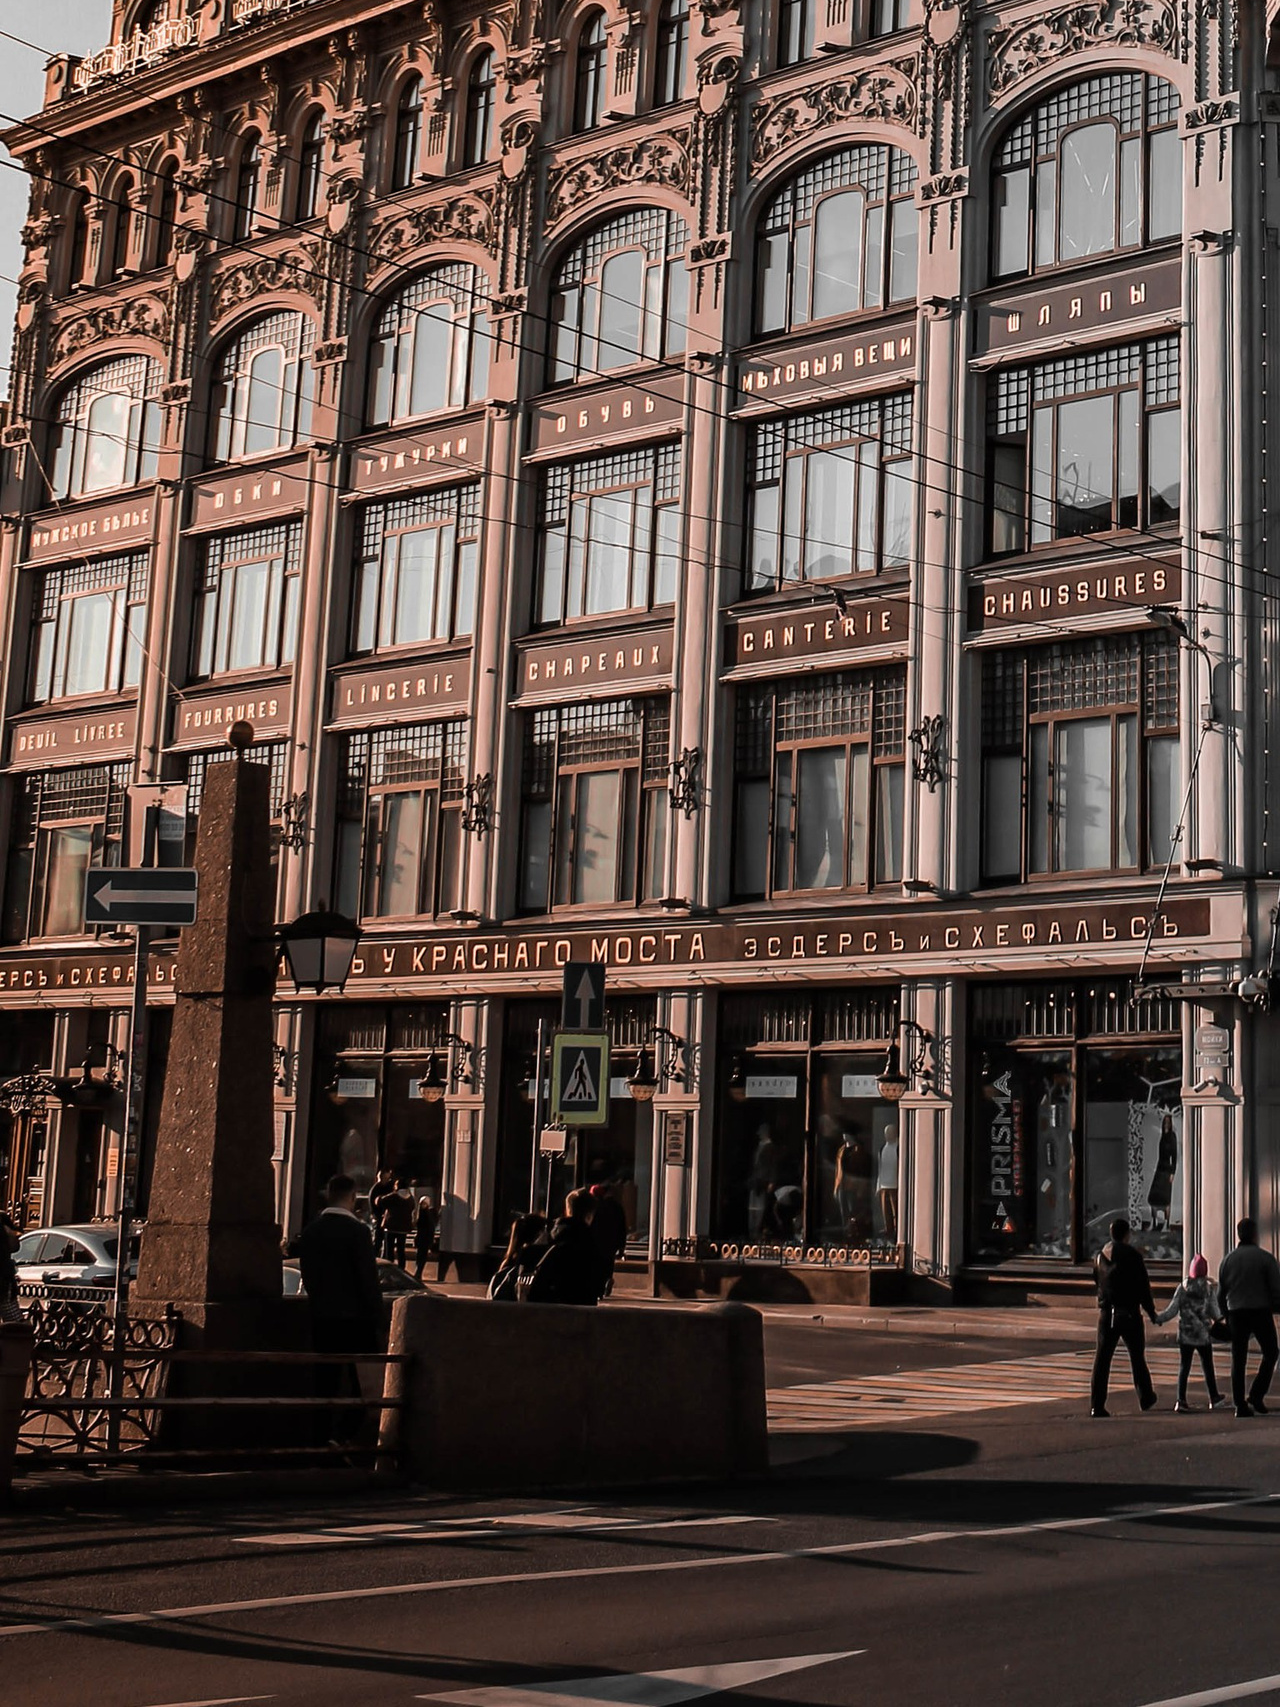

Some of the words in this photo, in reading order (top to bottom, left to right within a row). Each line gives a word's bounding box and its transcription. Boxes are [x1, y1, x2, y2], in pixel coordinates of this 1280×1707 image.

[1007, 283, 1146, 333] ШЛЯПЫ
[854, 336, 912, 368] ВЕЩИ
[556, 396, 655, 433] ОБУВЬ
[364, 437, 468, 476] ТУЖУРКИ
[32, 520, 97, 548] МУЖСКОЕ
[984, 569, 1167, 617] CHAUSSURES
[529, 645, 660, 681] CHAPEAUX
[184, 699, 278, 729] FOURRURES
[20, 730, 58, 752] DEUIL
[383, 947, 396, 973] У
[412, 940, 571, 972] КРАСНАГО
[591, 933, 706, 965] МОСТА
[744, 930, 905, 960] ЭСДЕРСЪ
[919, 935, 930, 950] и
[944, 915, 1179, 949] СХЕФАЛЬСЪ
[70, 963, 178, 985] СХЕФАЬС
[990, 1070, 1012, 1197] PRISMA
